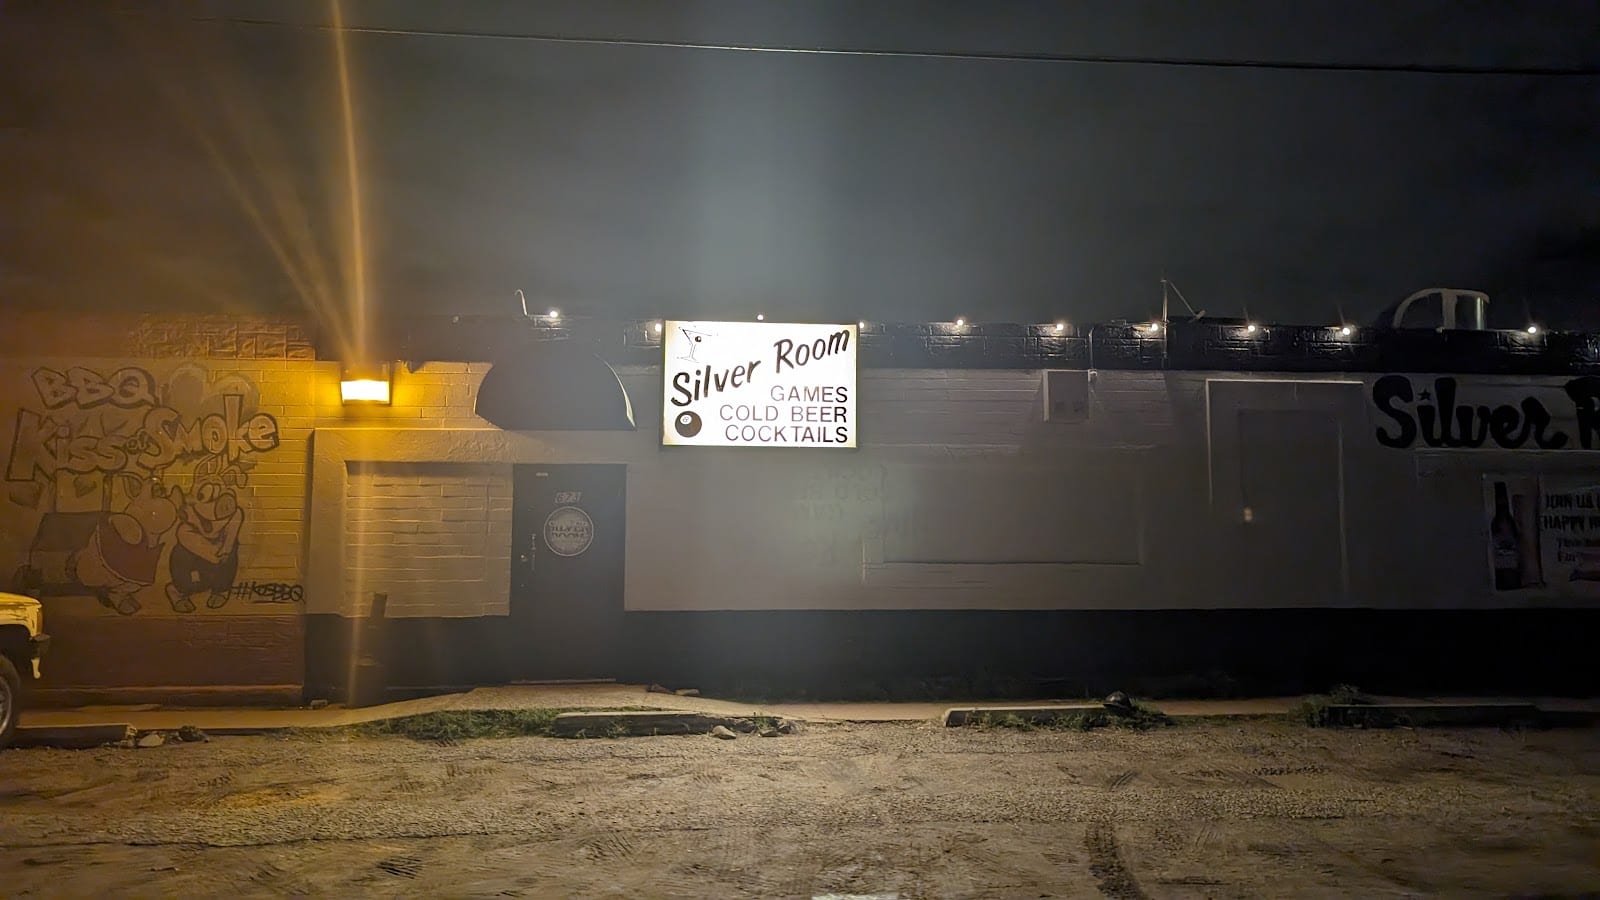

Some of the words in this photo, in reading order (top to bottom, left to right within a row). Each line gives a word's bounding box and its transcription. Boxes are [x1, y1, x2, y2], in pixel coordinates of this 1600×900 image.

[670, 361, 762, 407] Silver
[773, 329, 850, 374] Room
[31, 366, 160, 409] BBQ
[770, 385, 848, 403] GAMES
[719, 404, 779, 422] COLD
[791, 406, 847, 423] BEER
[1373, 375, 1568, 449] Silver
[5, 407, 129, 482] Kiss
[135, 393, 280, 470] Smoke
[725, 424, 848, 443] COCKTAILS
[1545, 494, 1572, 509] JOIN
[1543, 515, 1585, 531] HAPPY
